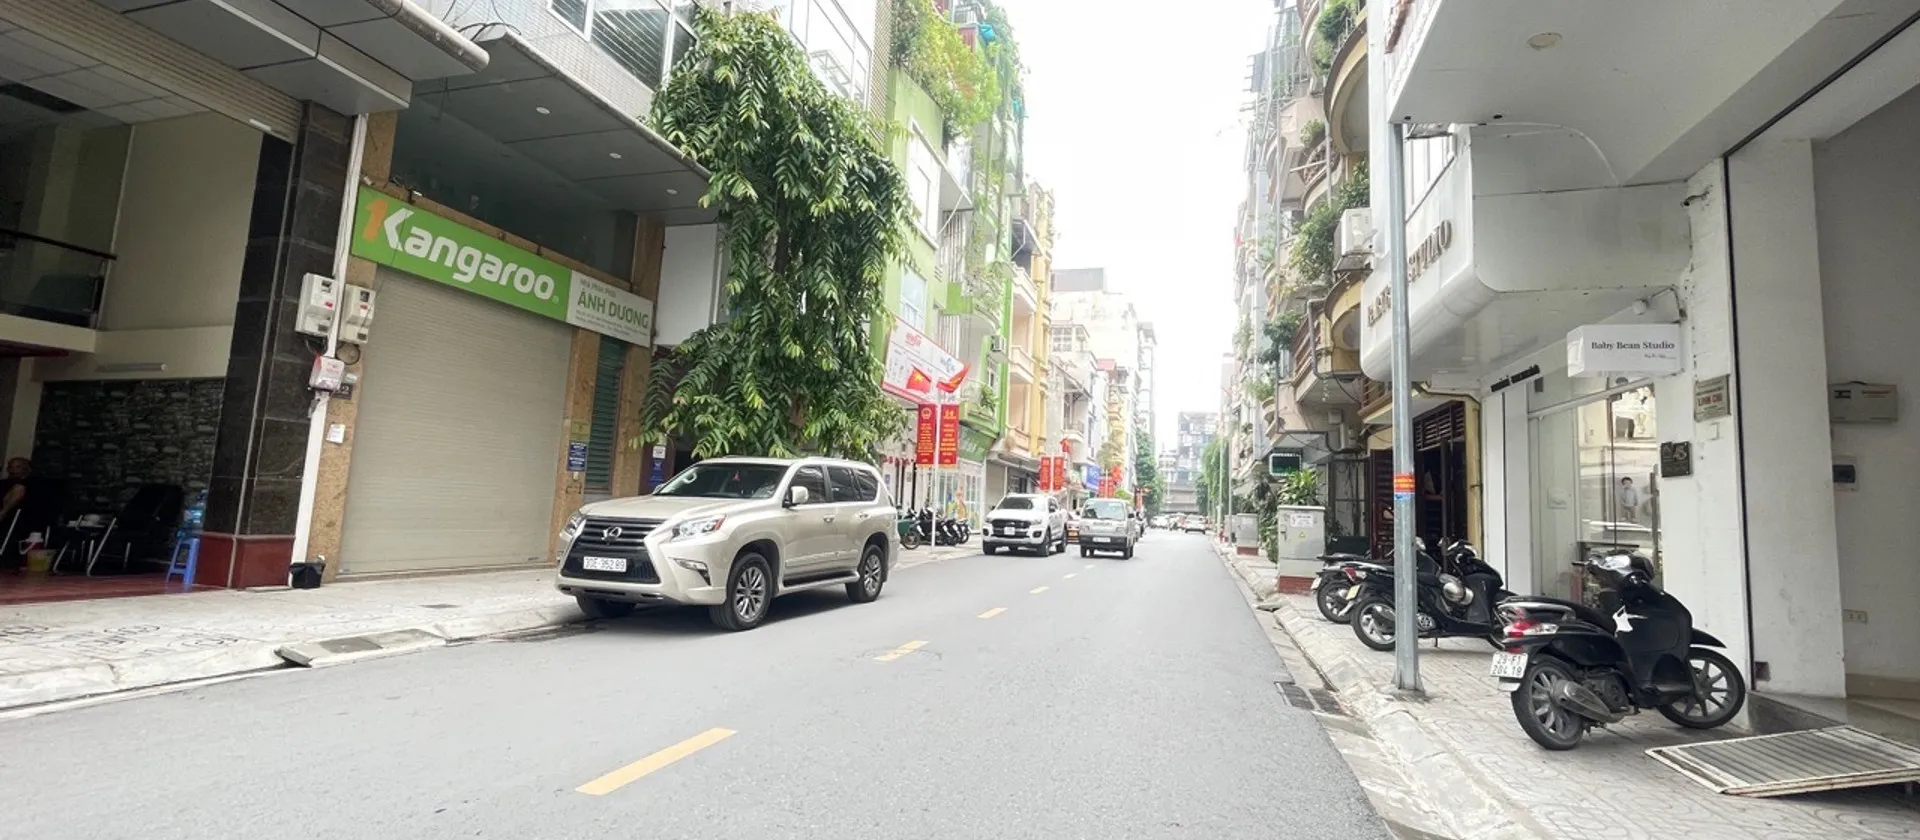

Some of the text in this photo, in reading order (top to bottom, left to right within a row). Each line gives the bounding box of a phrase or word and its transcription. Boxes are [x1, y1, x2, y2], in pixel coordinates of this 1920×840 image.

[1591, 340, 1676, 350] Baby Bean Studio
